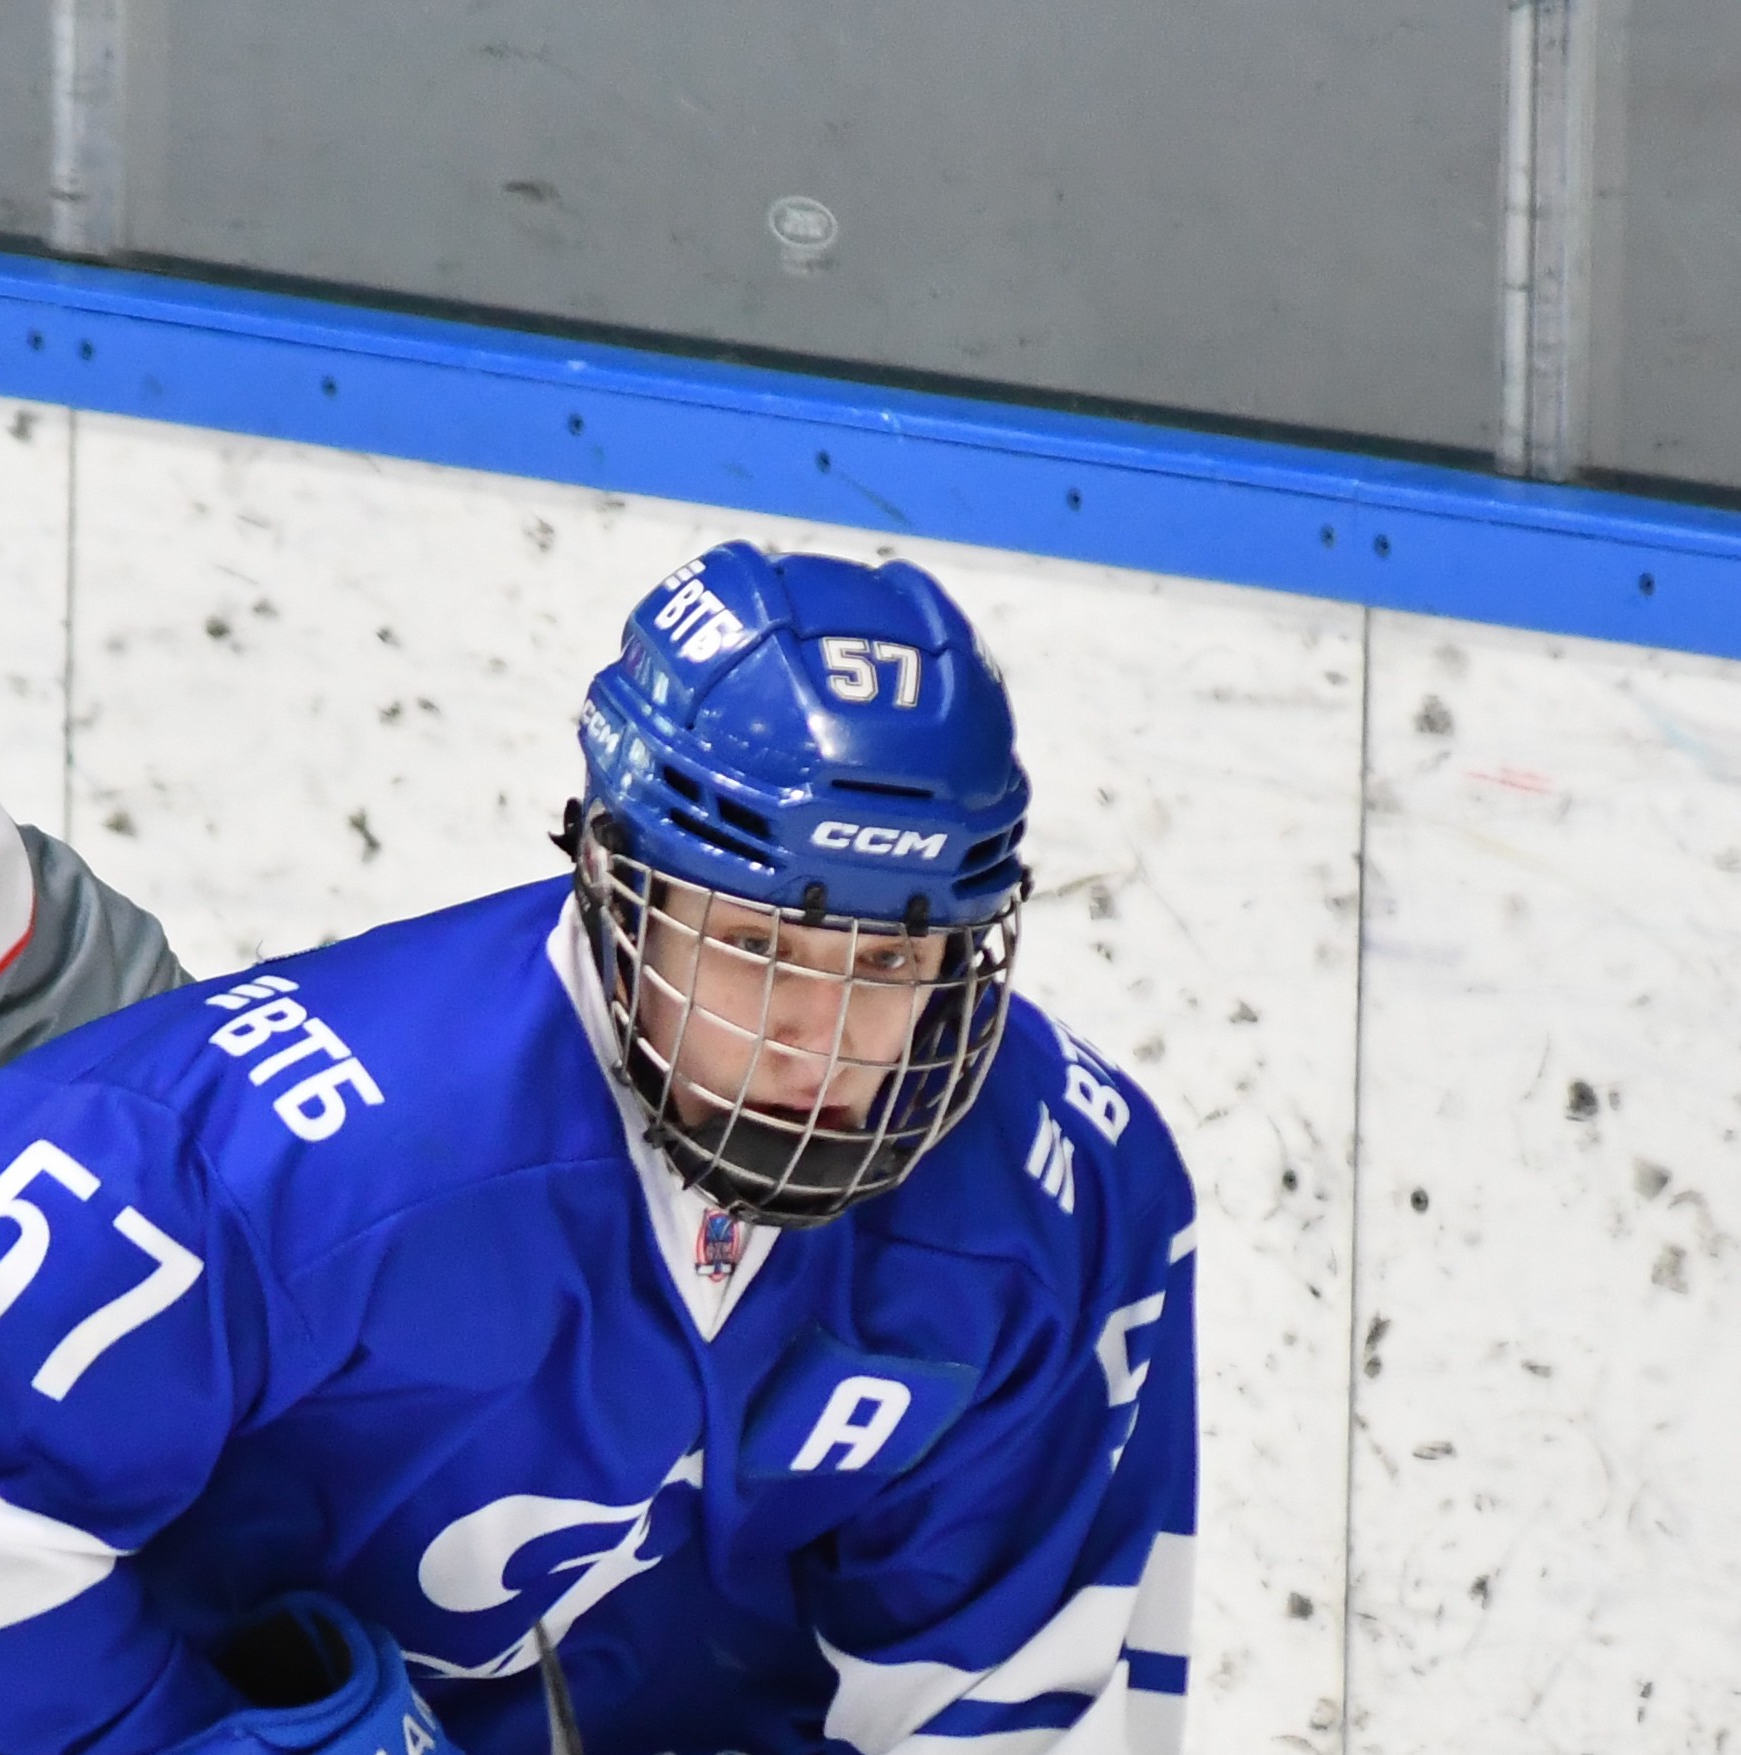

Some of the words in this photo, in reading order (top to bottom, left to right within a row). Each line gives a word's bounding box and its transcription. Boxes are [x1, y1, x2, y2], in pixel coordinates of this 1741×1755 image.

[654, 578, 744, 664] ВТБ
[820, 636, 921, 708] 57
[810, 820, 948, 860] CCM
[207, 996, 386, 1142] ВТБ
[790, 1375, 912, 1471] A
